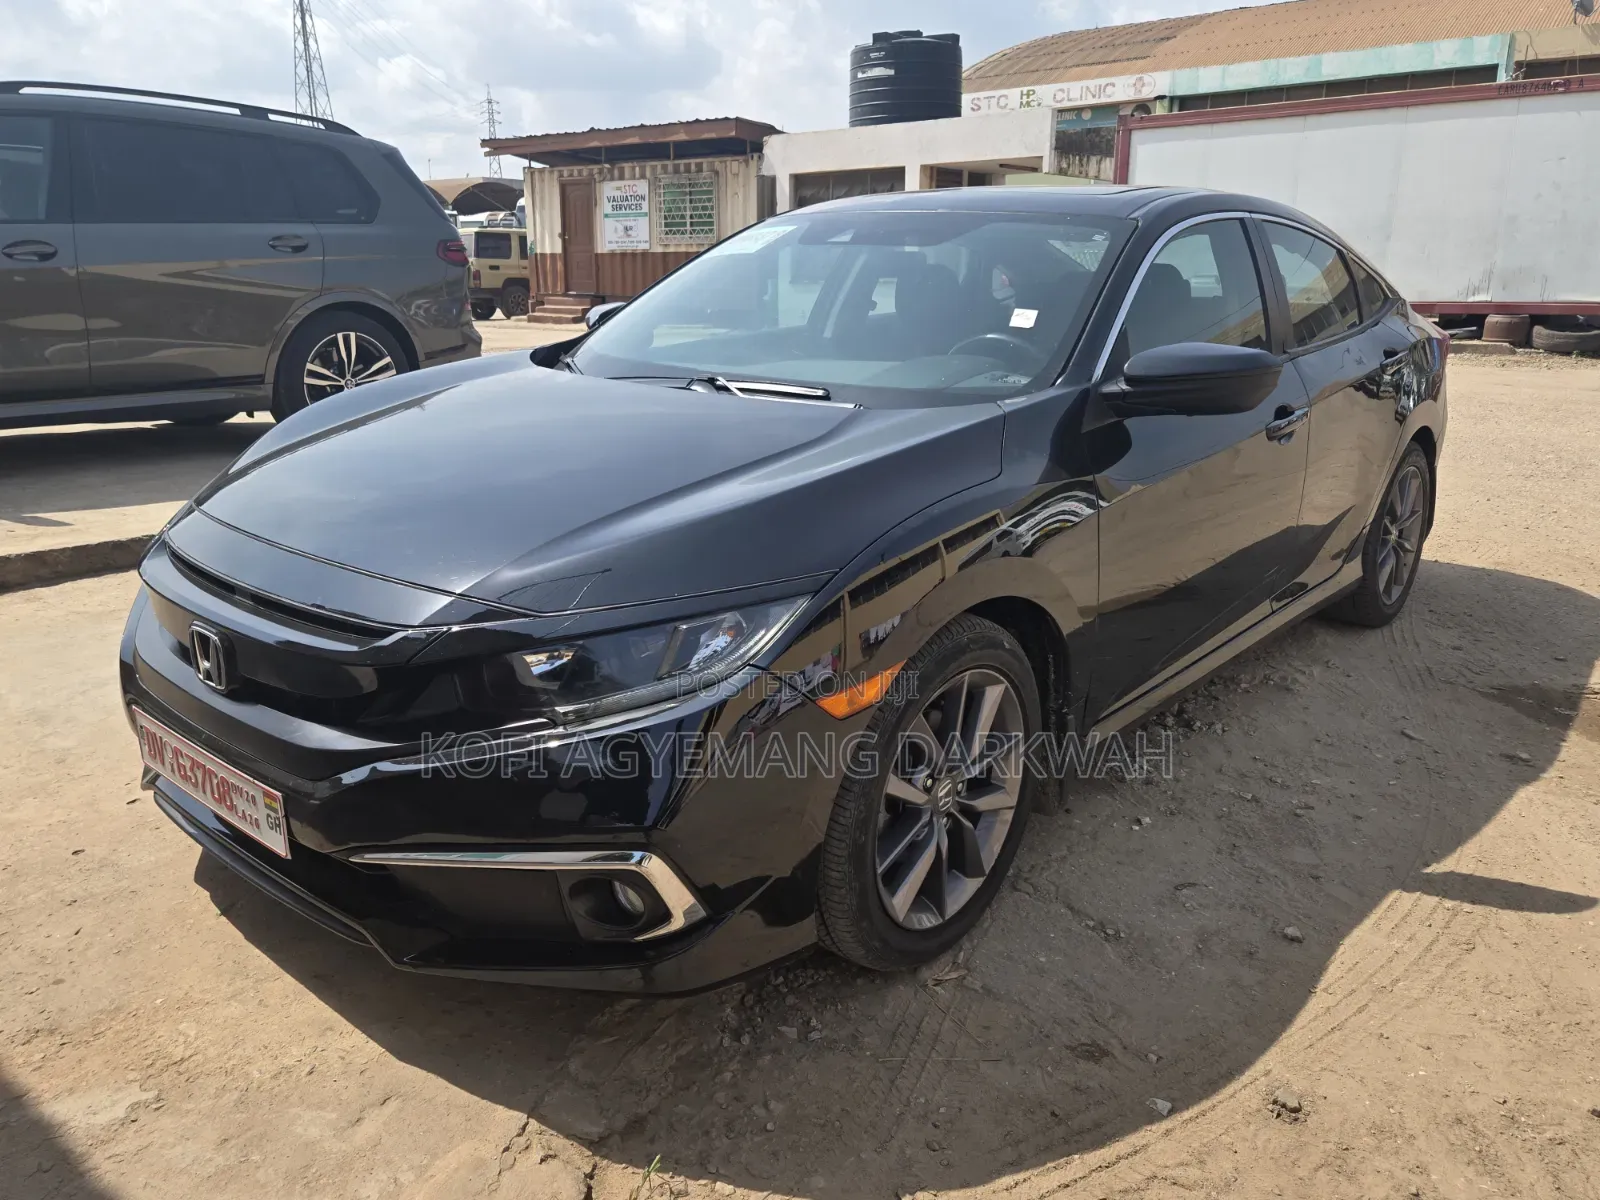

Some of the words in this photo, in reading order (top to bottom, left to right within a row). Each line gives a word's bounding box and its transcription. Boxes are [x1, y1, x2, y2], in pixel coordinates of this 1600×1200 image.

[970, 94, 1008, 112] STC
[1053, 82, 1116, 104] CLINIC
[1020, 88, 1036, 100] HP
[1019, 99, 1036, 109] MC
[623, 184, 638, 194] STC
[606, 194, 646, 203] VALUATION
[611, 203, 643, 212] SERVICES
